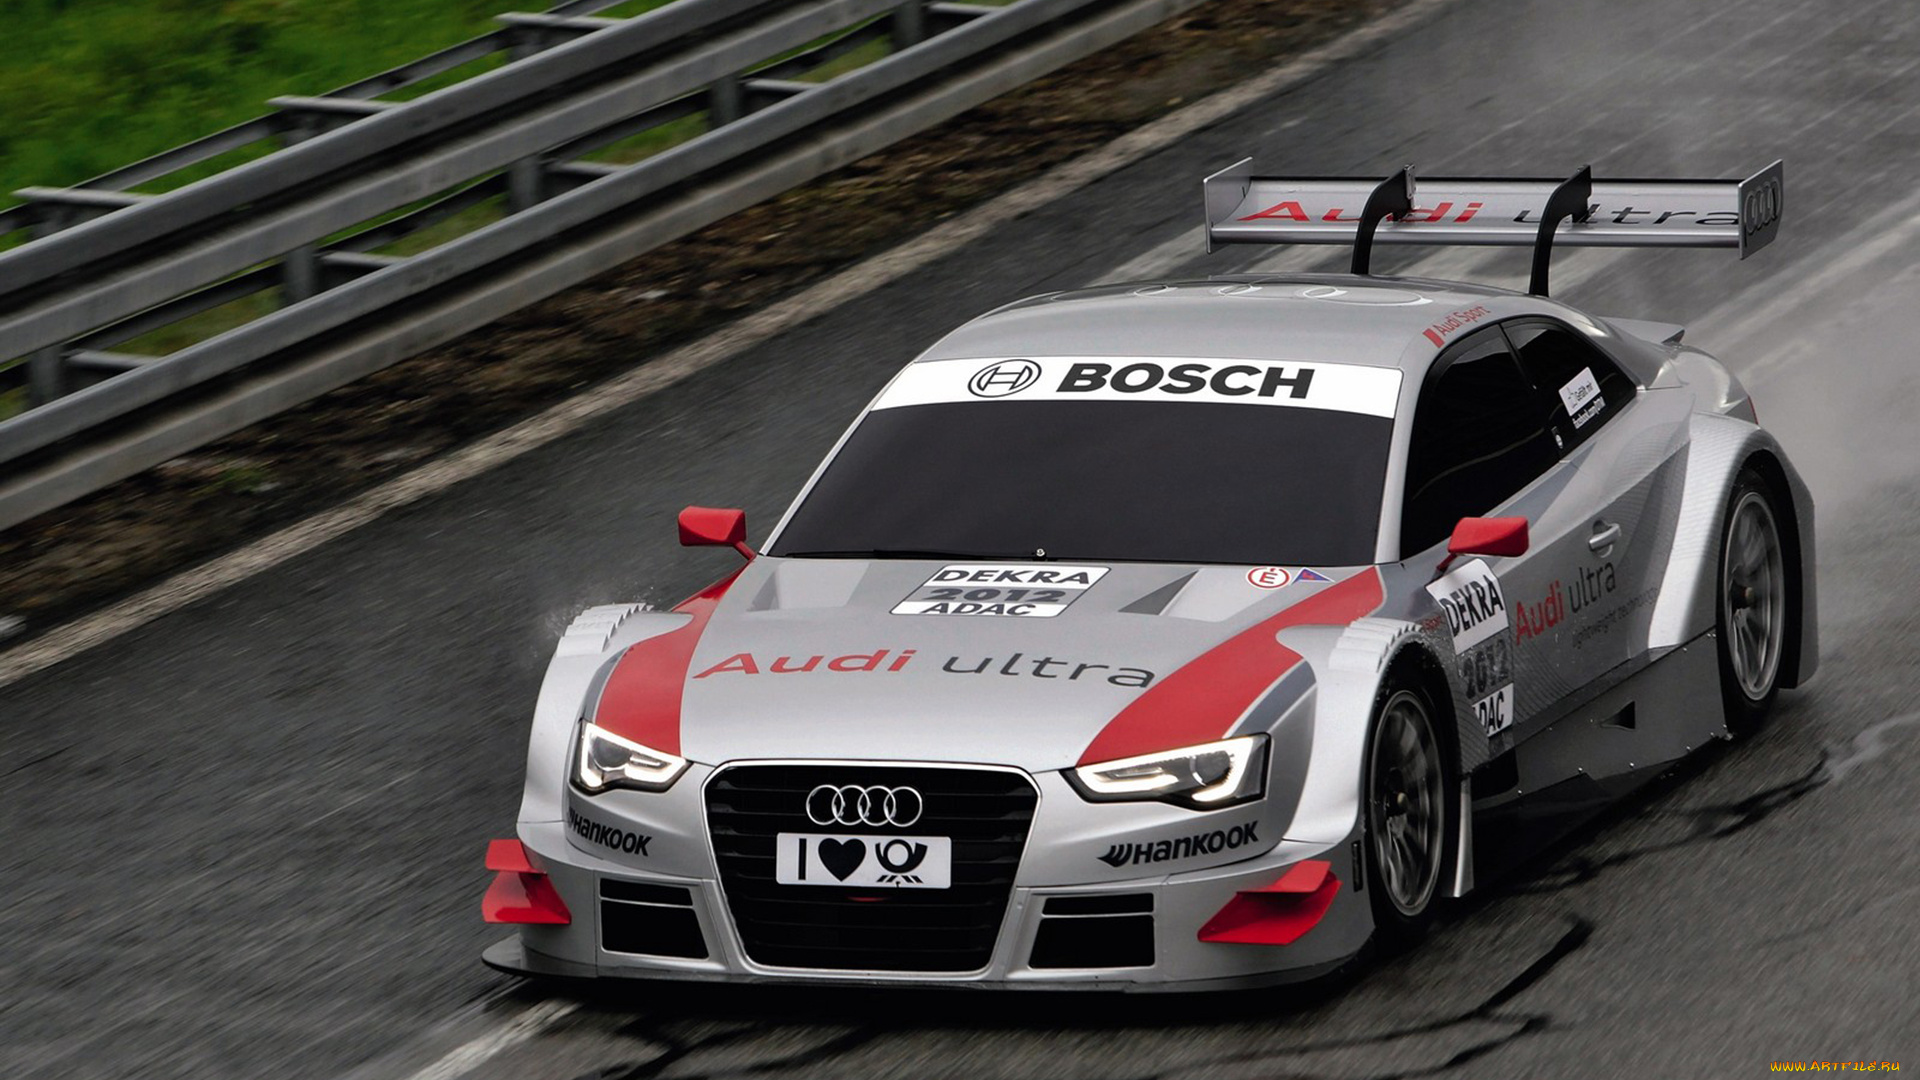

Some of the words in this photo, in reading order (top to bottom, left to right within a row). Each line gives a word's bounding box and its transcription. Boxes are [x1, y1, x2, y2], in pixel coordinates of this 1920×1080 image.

[1432, 314, 1463, 336] Audi
[1453, 304, 1491, 323] Sport
[1056, 362, 1315, 399] BOSCH
[923, 588, 1066, 603] 2012
[932, 569, 1090, 585] DEKRA
[921, 602, 1036, 616] ADAC
[1439, 574, 1504, 638] DEKRA
[1516, 579, 1565, 646] Audi
[1568, 562, 1616, 614] ultra
[692, 649, 918, 680] Audi
[941, 652, 1156, 690] ultra
[1472, 690, 1505, 735] DAC
[798, 838, 807, 881] I
